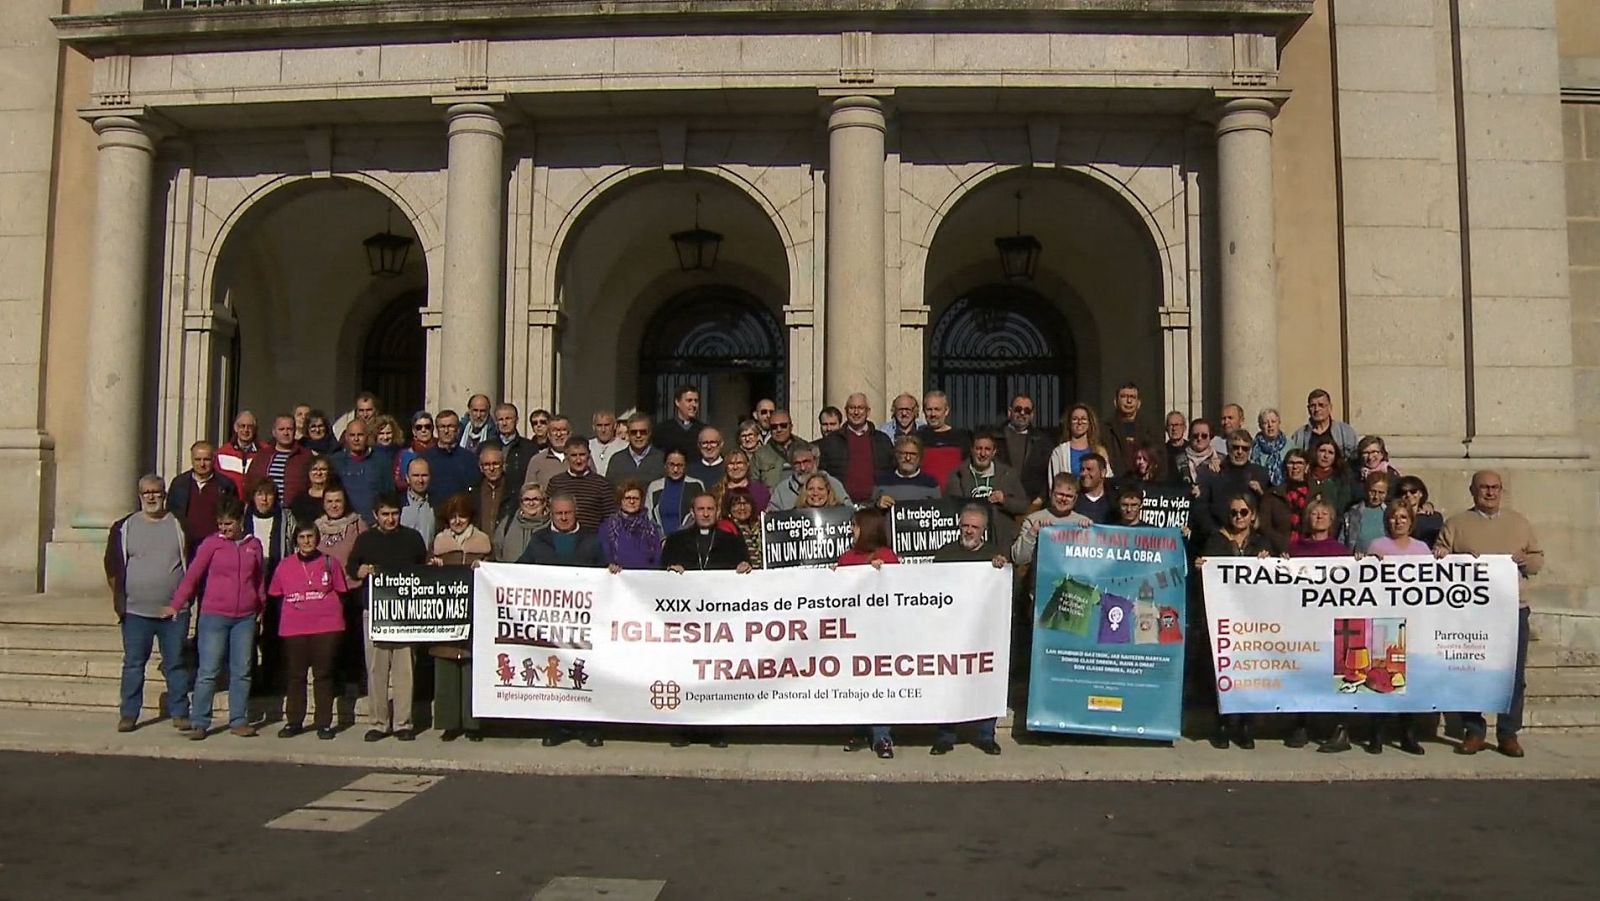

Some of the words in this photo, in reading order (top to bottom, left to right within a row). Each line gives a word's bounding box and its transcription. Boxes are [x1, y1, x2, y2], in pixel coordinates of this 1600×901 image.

[1142, 498, 1158, 507] ara
[1160, 496, 1168, 507] la
[1171, 497, 1190, 509] vida
[897, 507, 905, 520] el
[907, 506, 940, 521] trabajo
[919, 519, 930, 528] es
[932, 517, 954, 530] para
[956, 513, 961, 526] l
[1139, 509, 1166, 528] UERTO
[767, 519, 775, 532] el
[777, 516, 811, 531] trabajo
[789, 529, 800, 538] es
[803, 527, 824, 540] para
[827, 523, 836, 535] la
[838, 521, 852, 535] vid
[767, 543, 782, 563] ¡NI
[783, 541, 797, 561] UN
[799, 538, 835, 560] MUERTO
[897, 532, 911, 552] ¡NI
[913, 531, 927, 551] UN
[1065, 545, 1104, 558] MANOS
[1106, 548, 1115, 560] A
[1117, 550, 1131, 561] LA
[1133, 551, 1162, 564] OBRA
[375, 573, 384, 587] el
[386, 573, 421, 589] trabajo
[1217, 564, 1350, 585] TRABAJO
[1359, 562, 1490, 583] DECENTE
[398, 587, 409, 596] es
[411, 585, 434, 598] para
[437, 581, 446, 595] la
[448, 581, 469, 595] vida
[496, 586, 593, 609] DEFENDEMOS
[1301, 587, 1378, 608] PARA
[1385, 584, 1490, 609] TOD@S
[374, 599, 389, 620] ¡NI
[391, 600, 405, 620] UN
[407, 598, 444, 620] MUERTO
[446, 595, 468, 619] MÁS!
[655, 598, 691, 612] XXIX
[696, 598, 768, 612] Jornadas
[773, 598, 792, 611] de
[797, 594, 861, 610] Pastoral
[866, 593, 889, 607] del
[893, 592, 953, 609] Trabajo
[497, 606, 513, 620] EL
[518, 608, 591, 625] TRABAJO
[497, 621, 592, 644] DECENTE
[610, 620, 734, 643] IGLESIA
[745, 619, 808, 642] POR
[819, 618, 857, 640] EL
[1217, 618, 1281, 635] EQUIPO
[1217, 637, 1321, 654] PARROQUIAL
[1434, 630, 1489, 643] Parroquia
[1217, 656, 1301, 672] PASTORAL
[1445, 649, 1486, 660] Linares
[692, 655, 841, 680] TRABAJO
[852, 652, 994, 677] DECENTE
[685, 690, 755, 703] Departamento
[757, 690, 770, 700] de
[772, 689, 811, 700] Pastoral
[814, 688, 829, 699] del
[831, 688, 869, 701] Trabajo
[872, 688, 884, 699] de
[887, 687, 896, 698] la
[898, 687, 922, 698] CEE
